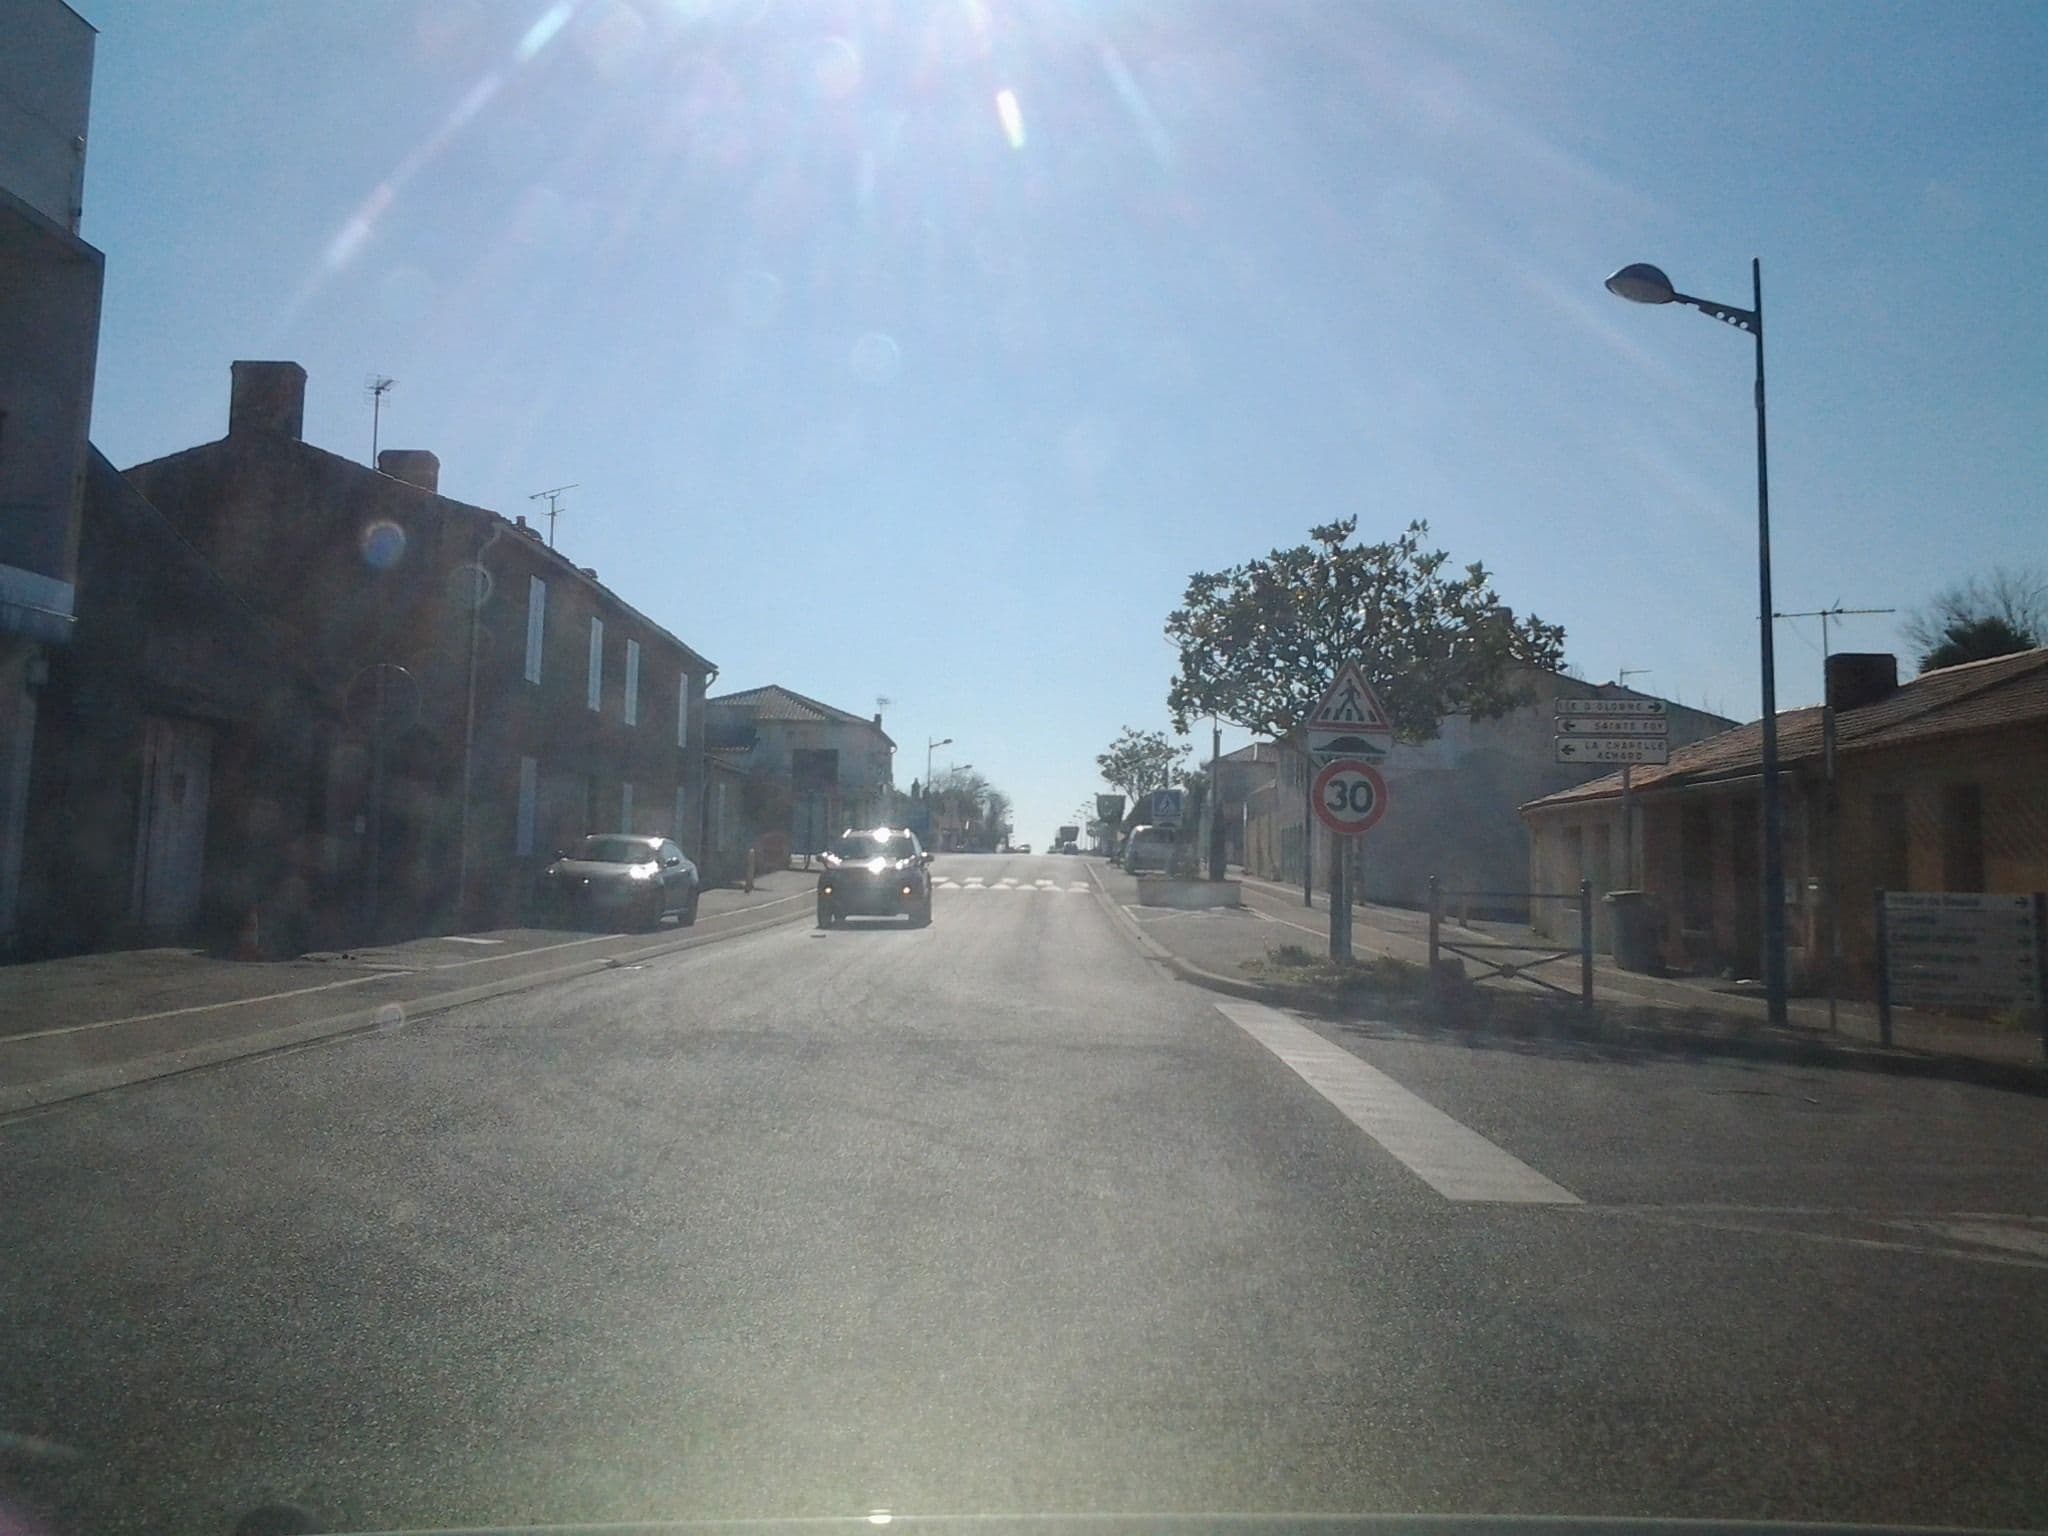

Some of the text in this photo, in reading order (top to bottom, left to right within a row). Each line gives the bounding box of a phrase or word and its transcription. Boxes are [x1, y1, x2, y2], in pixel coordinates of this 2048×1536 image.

[1594, 722, 1664, 731] SAINTE FOY
[1585, 742, 1665, 751] LA CHAPELLE
[1597, 752, 1643, 761] ACHARD
[1327, 780, 1373, 813] 30
